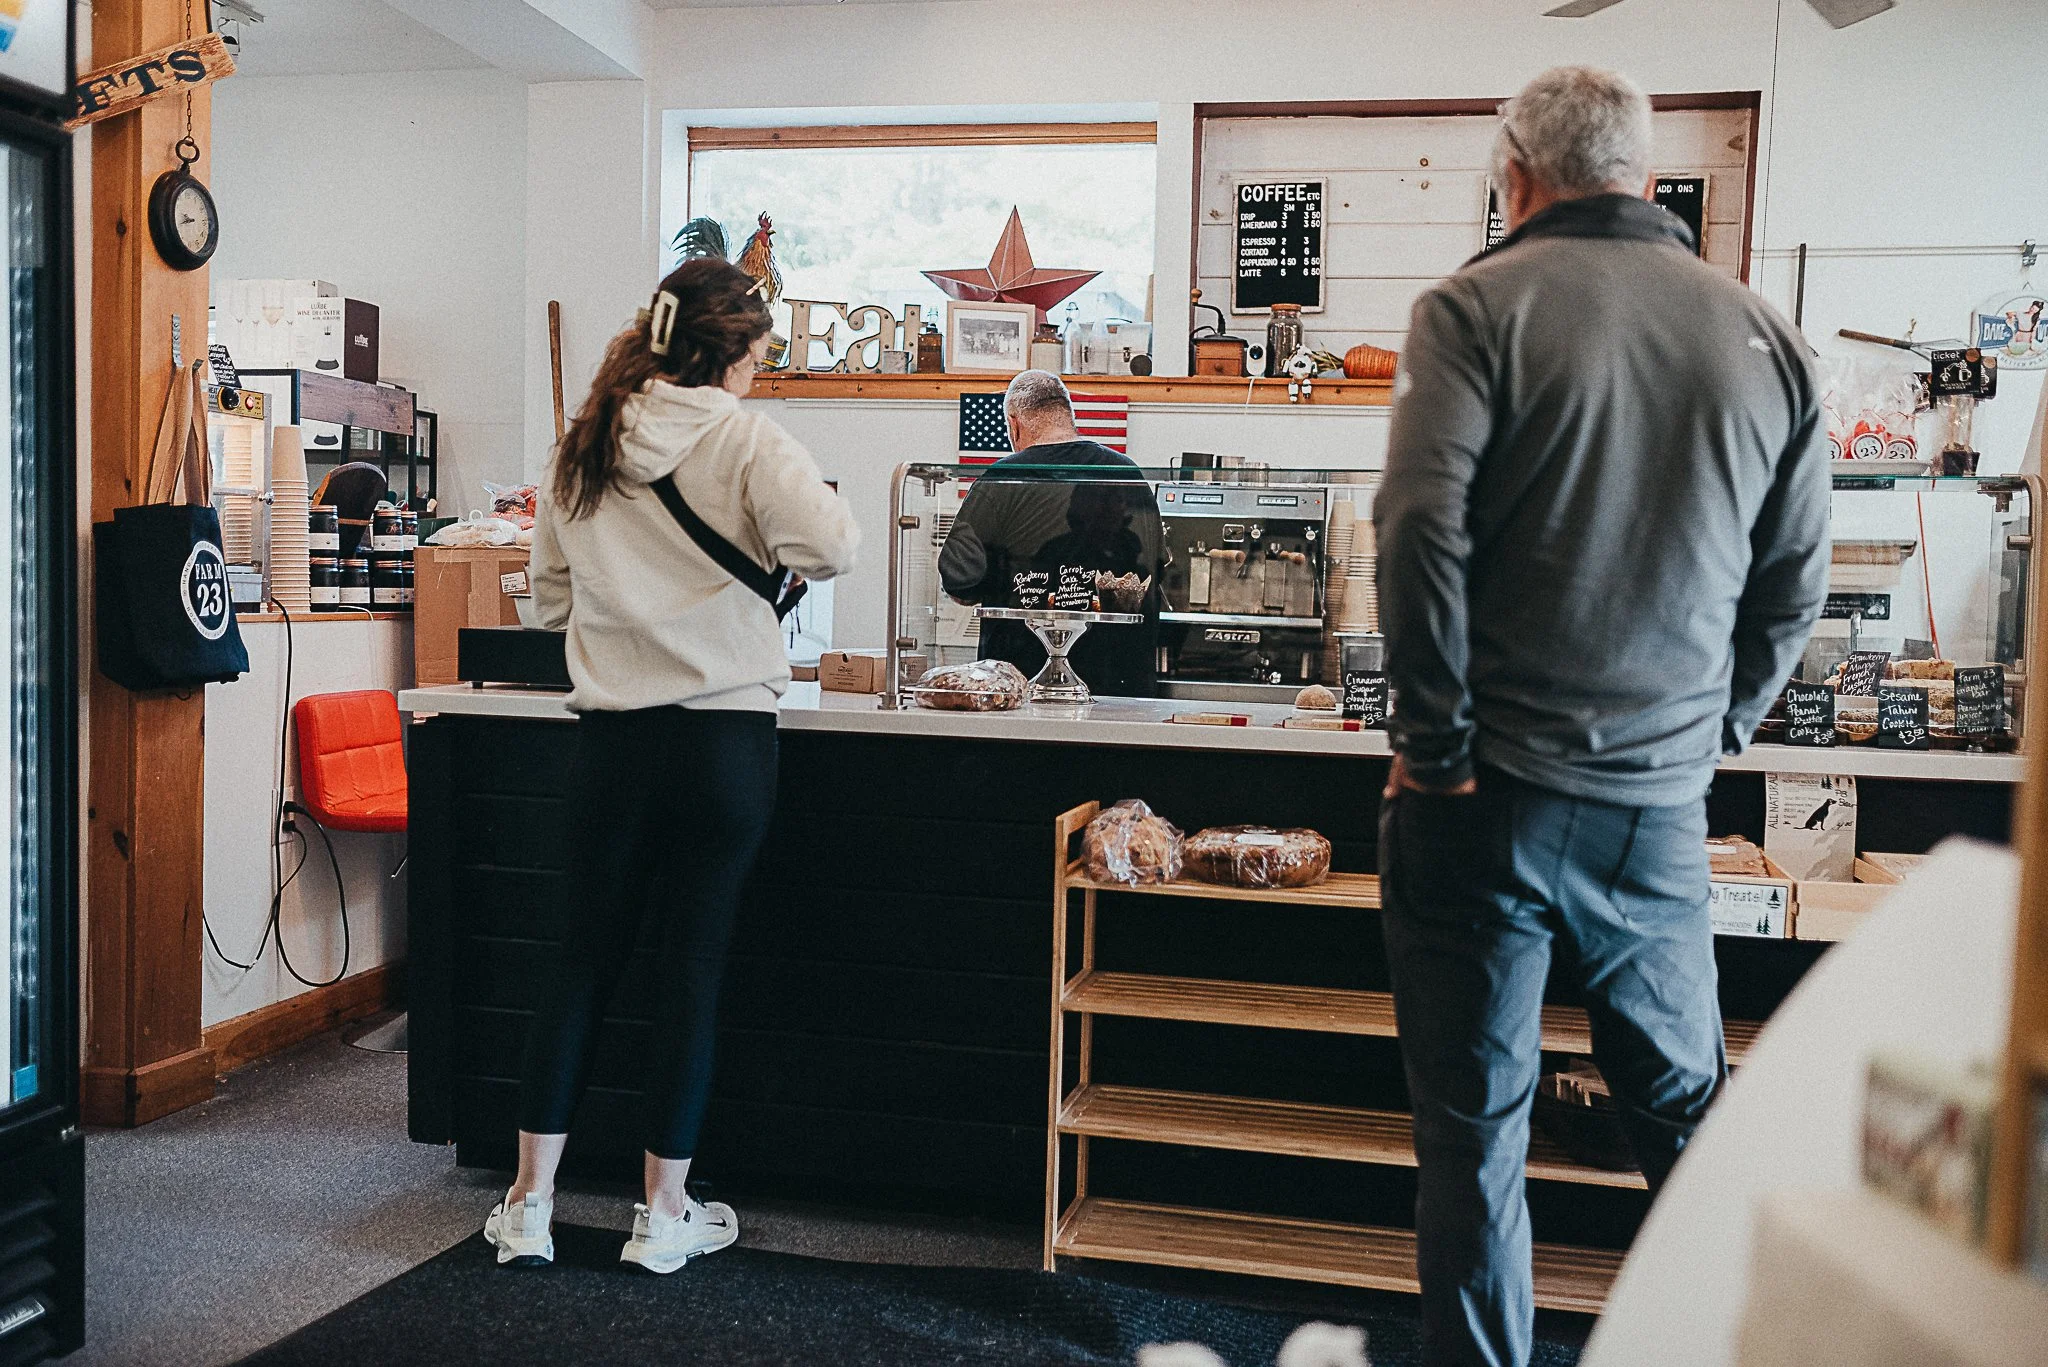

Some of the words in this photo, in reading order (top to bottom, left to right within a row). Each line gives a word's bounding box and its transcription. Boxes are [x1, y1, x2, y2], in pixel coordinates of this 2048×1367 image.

[76, 49, 206, 115] FTS
[1241, 184, 1307, 202] COFFEE
[1307, 192, 1321, 201] ETC
[1656, 184, 1672, 193] ADD
[1677, 184, 1694, 193] ONS
[1283, 203, 1295, 211] SM
[1305, 203, 1315, 211] LG
[1240, 212, 1256, 221] DRIP
[1282, 212, 1288, 220] 3
[1303, 211, 1309, 219] 3
[1240, 220, 1278, 229] AMERICANO
[1281, 220, 1287, 228] 3
[1303, 220, 1309, 228] 3
[1241, 237, 1276, 246] ESPRESSO
[1281, 237, 1287, 245] 2
[1303, 236, 1309, 244] 3
[1240, 247, 1269, 256] CORTADO
[1280, 247, 1286, 255] 4
[1304, 247, 1309, 255] 6
[1240, 258, 1278, 267] CAPPUCCINO
[1240, 268, 1261, 277] LATTE
[1280, 268, 1287, 276] 5
[782, 298, 928, 374] Eat
[1983, 322, 2007, 341] BAKE
[1933, 351, 1960, 360] ticket
[1860, 445, 1878, 457] 23
[195, 563, 222, 580] FARM
[1060, 565, 1084, 575] Carrot
[1013, 570, 1049, 585] Raspberry
[1060, 575, 1079, 584] Cake
[1013, 583, 1047, 595] Turnover
[1057, 583, 1085, 594] Muffin
[196, 582, 223, 617] 23
[1213, 631, 1251, 641] Astra
[1849, 653, 1886, 665] Strawberry
[1848, 662, 1876, 673] Mango
[1345, 672, 1387, 686] Cinnamon
[1843, 670, 1871, 685] French
[1958, 669, 1980, 684] Farm
[1983, 668, 1996, 679] 23
[1350, 684, 1377, 697] Sugar
[1842, 673, 1876, 695] Custard
[1786, 688, 1830, 703] Chocolate
[1879, 689, 1923, 702] Sesame
[1786, 703, 1822, 717] Peanut
[1881, 703, 1918, 716] Tahini
[1882, 717, 1918, 730] Cookie
[1789, 727, 1821, 739] Cookie
[1767, 771, 1779, 813] NATURAL
[1767, 813, 1779, 830] ALL
[1722, 886, 1764, 903] Treats!
